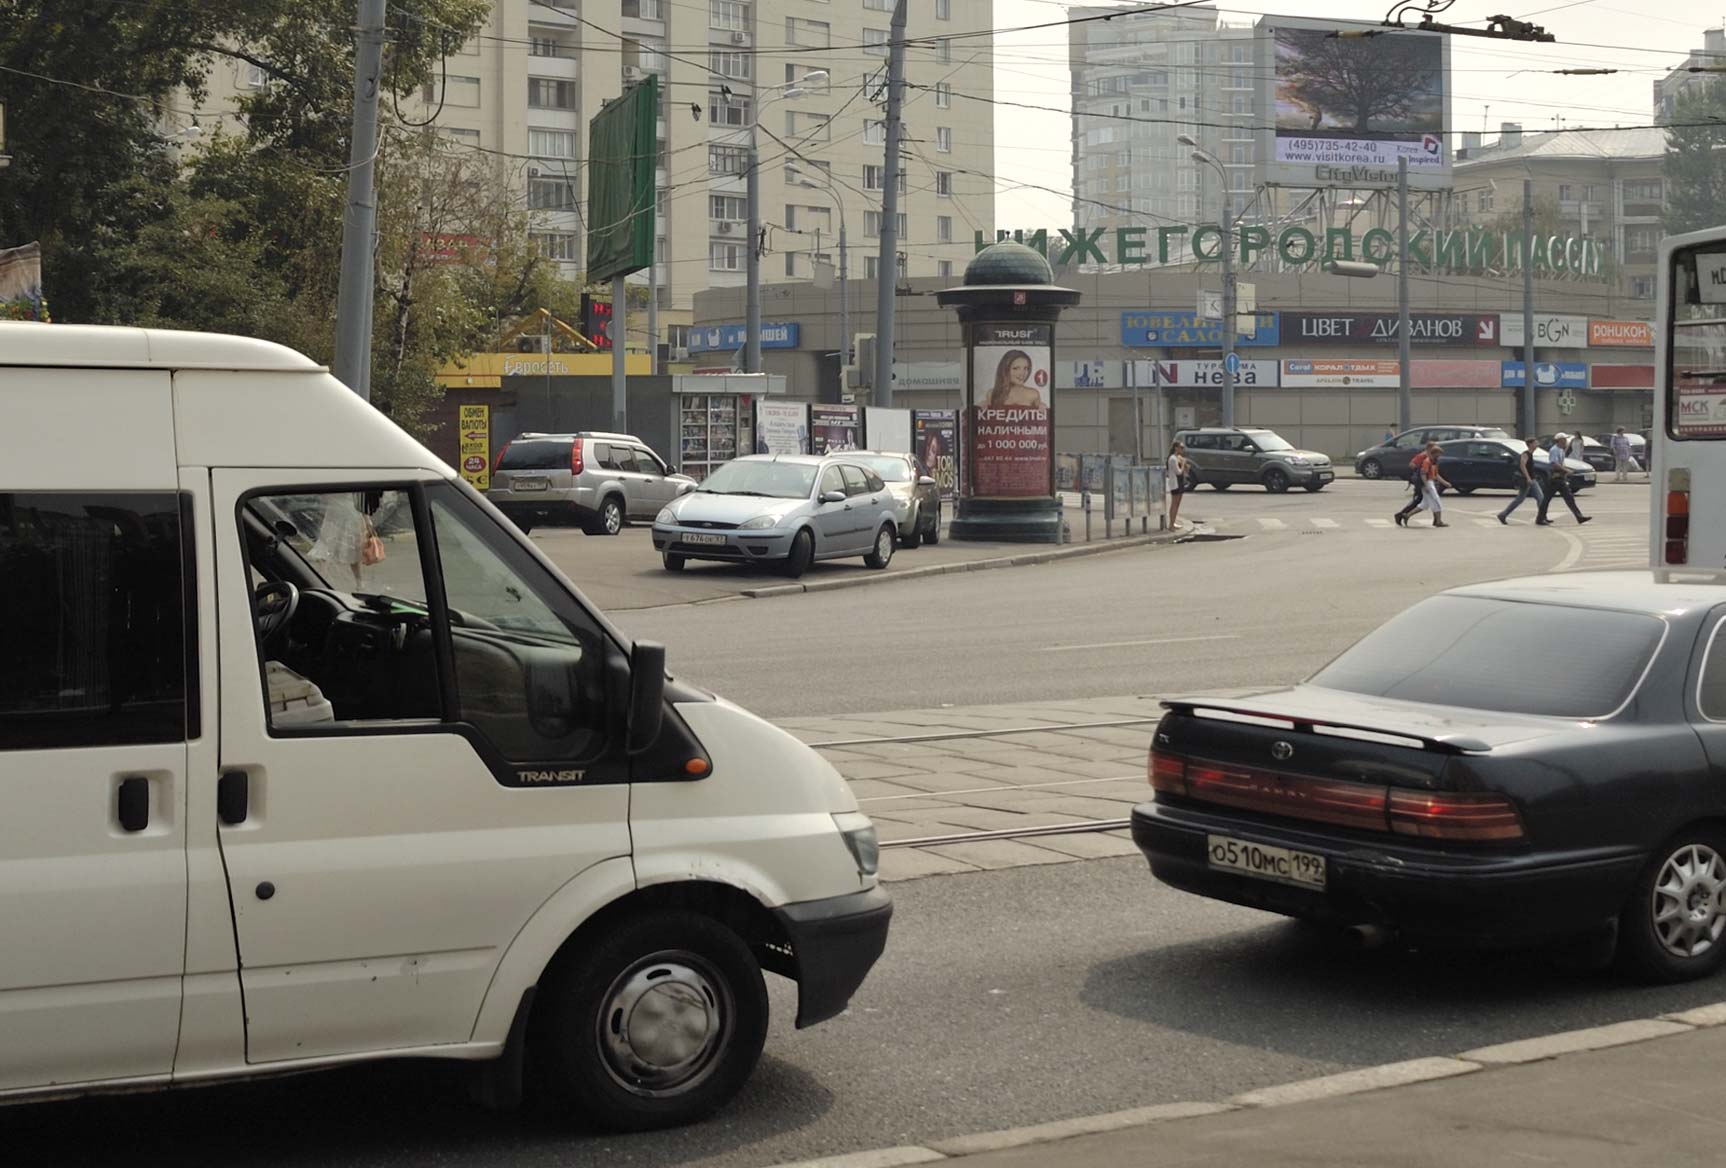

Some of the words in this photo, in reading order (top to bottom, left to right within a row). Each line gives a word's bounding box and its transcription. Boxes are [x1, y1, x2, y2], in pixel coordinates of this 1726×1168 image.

[1288, 139, 1377, 152] (495)735-42-40
[1285, 151, 1385, 164] www.visitkorea.ru
[1302, 318, 1354, 337] ЦВЕТ
[1680, 400, 1709, 414] МСК
[977, 408, 1047, 423] КРЕДИТЫ
[977, 425, 1047, 436] НАЛИЧНЫМИ
[517, 770, 586, 782] TRANSIT
[1293, 854, 1321, 876] 199
